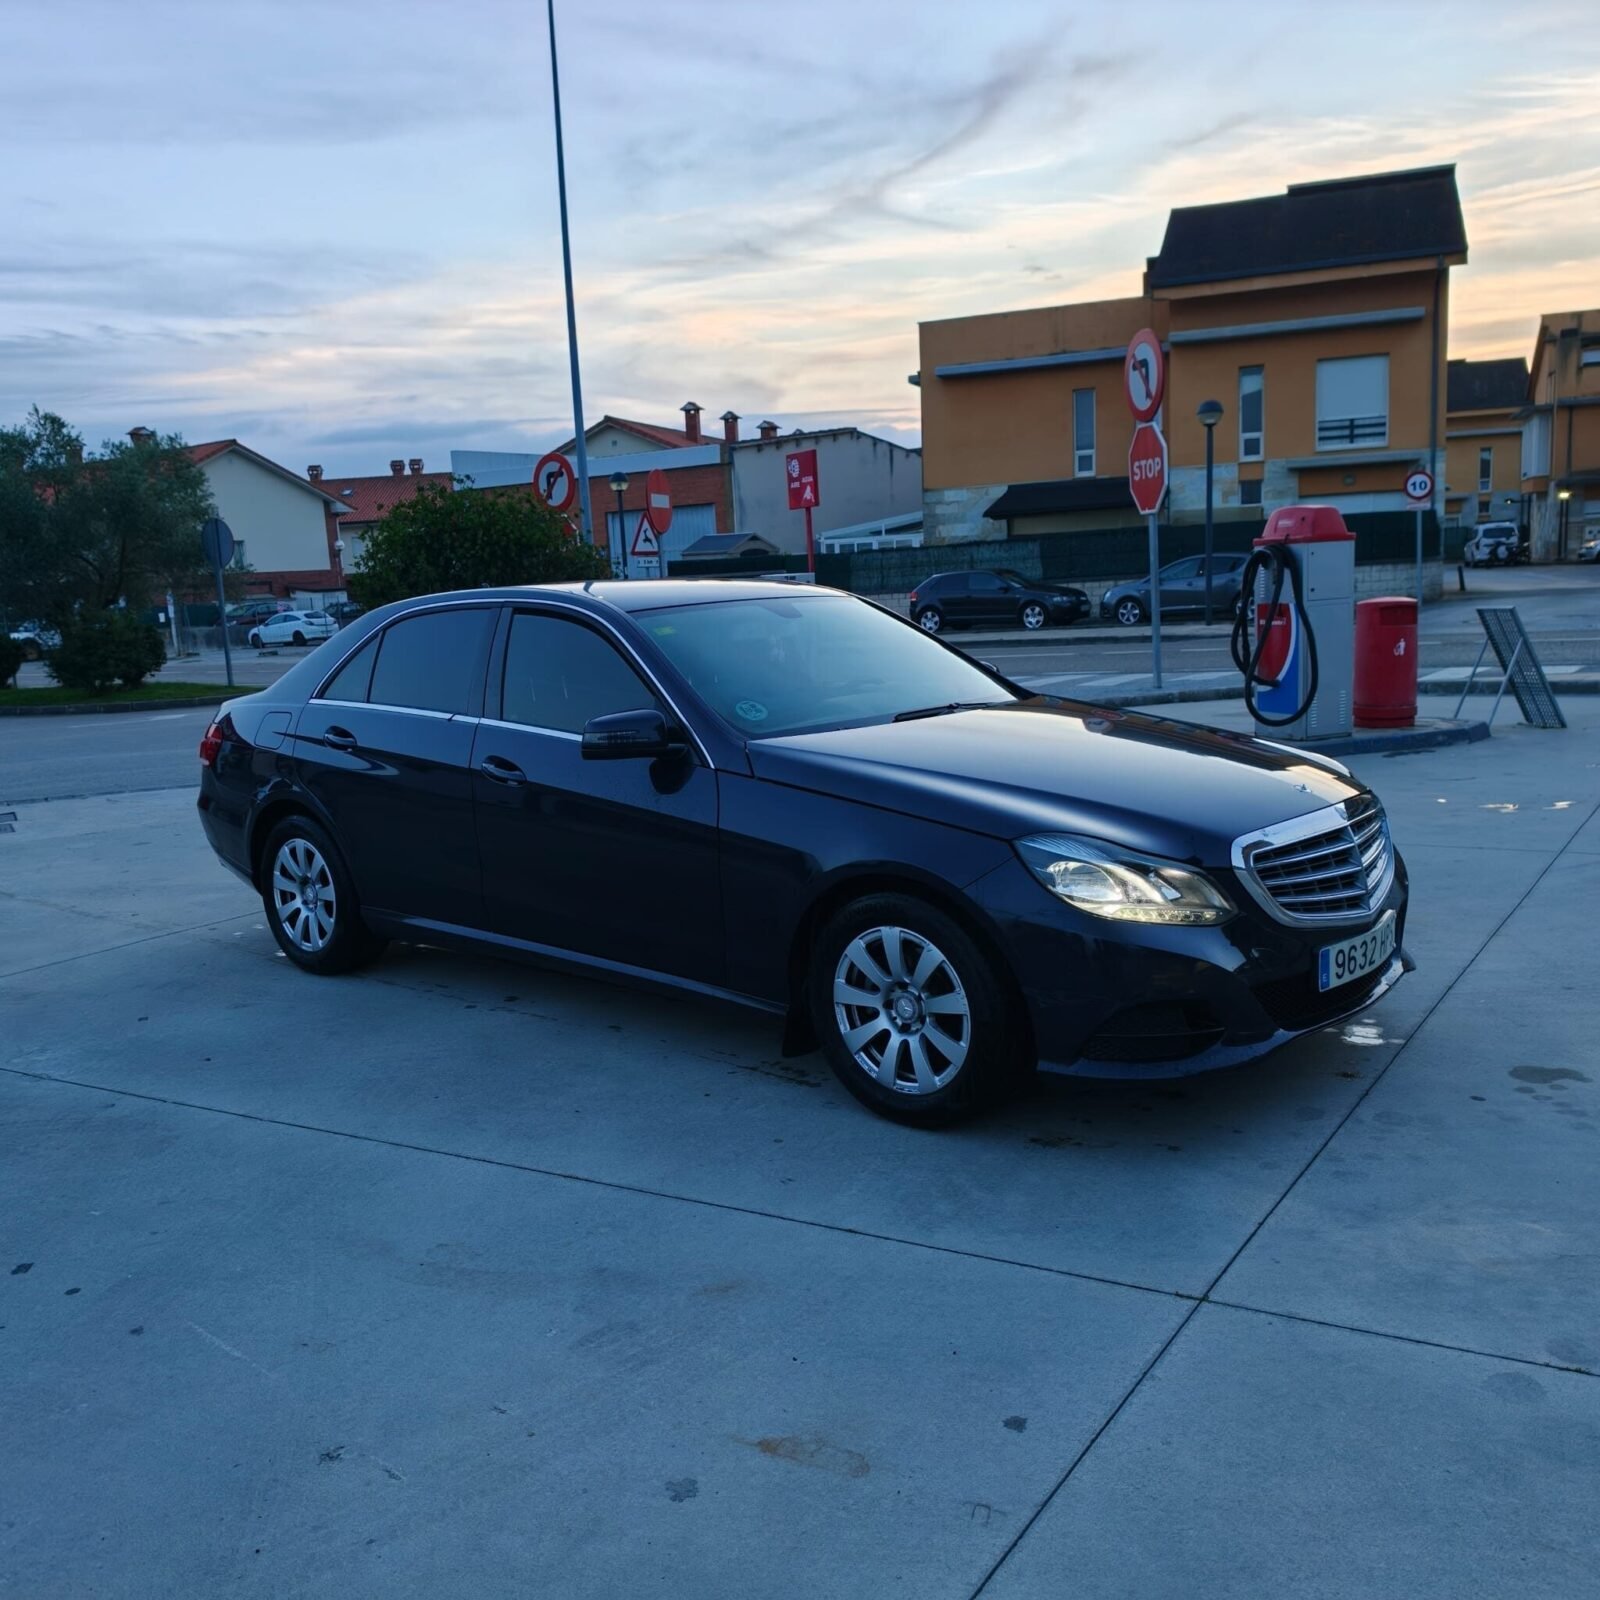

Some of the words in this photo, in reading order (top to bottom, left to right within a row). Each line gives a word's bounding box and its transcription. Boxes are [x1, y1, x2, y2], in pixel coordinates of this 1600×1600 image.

[1133, 457, 1161, 480] STOP
[1410, 481, 1428, 491] 10
[1335, 936, 1377, 979] 9632
